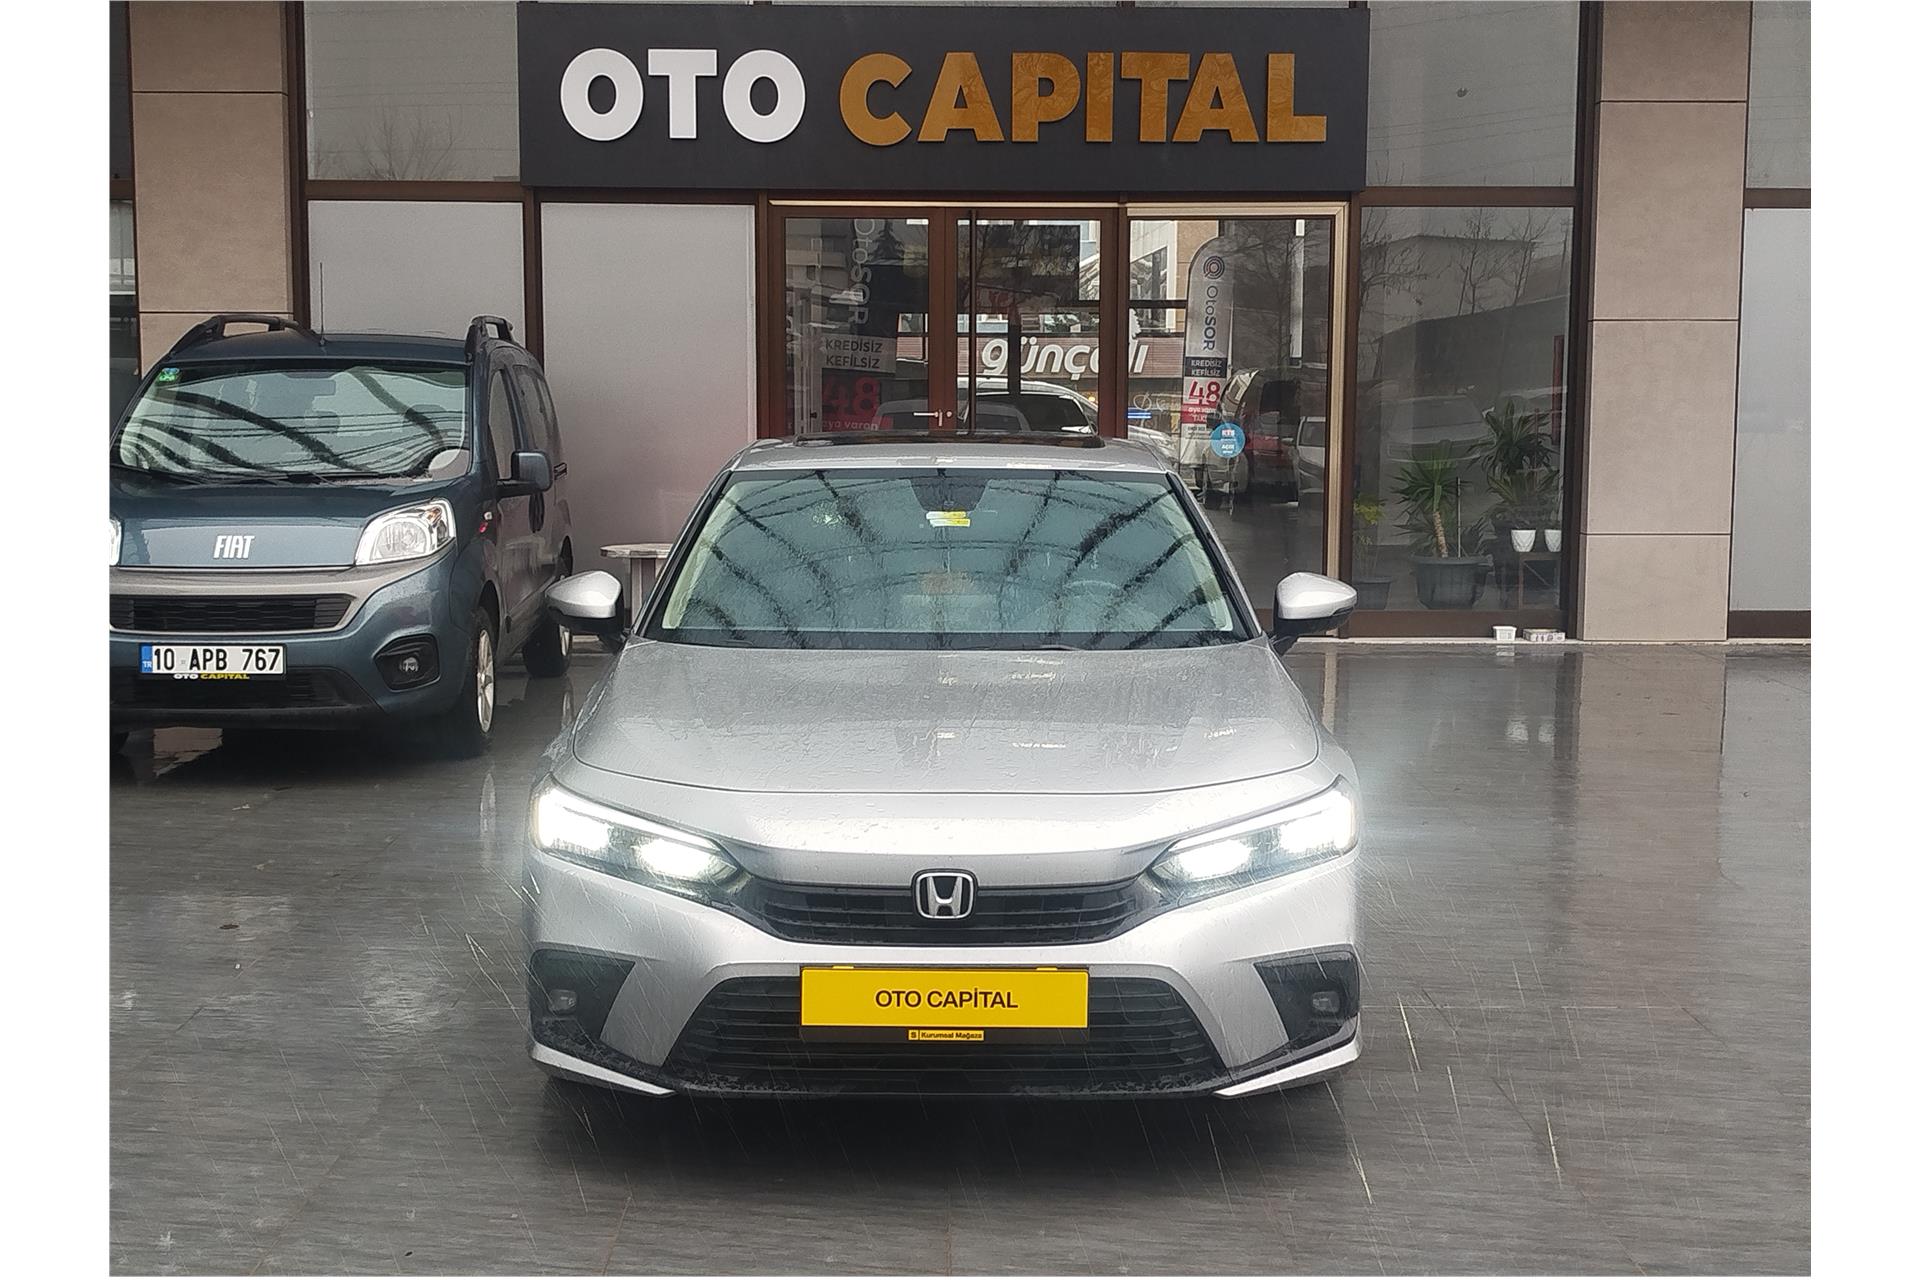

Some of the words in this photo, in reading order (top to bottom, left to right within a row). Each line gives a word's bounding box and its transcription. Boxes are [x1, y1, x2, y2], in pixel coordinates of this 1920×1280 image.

[560, 48, 806, 143] OTO
[840, 51, 1327, 146] CAPITAL
[1203, 285, 1219, 351] OtoSOR
[826, 340, 882, 353] KREDİSİZ
[826, 354, 880, 369] KEFİLSİZ
[1188, 380, 1221, 405] 48
[213, 535, 256, 559] FIAT
[142, 660, 152, 669] TR
[154, 649, 174, 671] 10
[189, 649, 227, 671] APB
[242, 649, 281, 671] 767
[875, 989, 922, 1008] OTO
[926, 987, 1018, 1009] CAPİTAL
[955, 1032, 982, 1040] Mağaza
